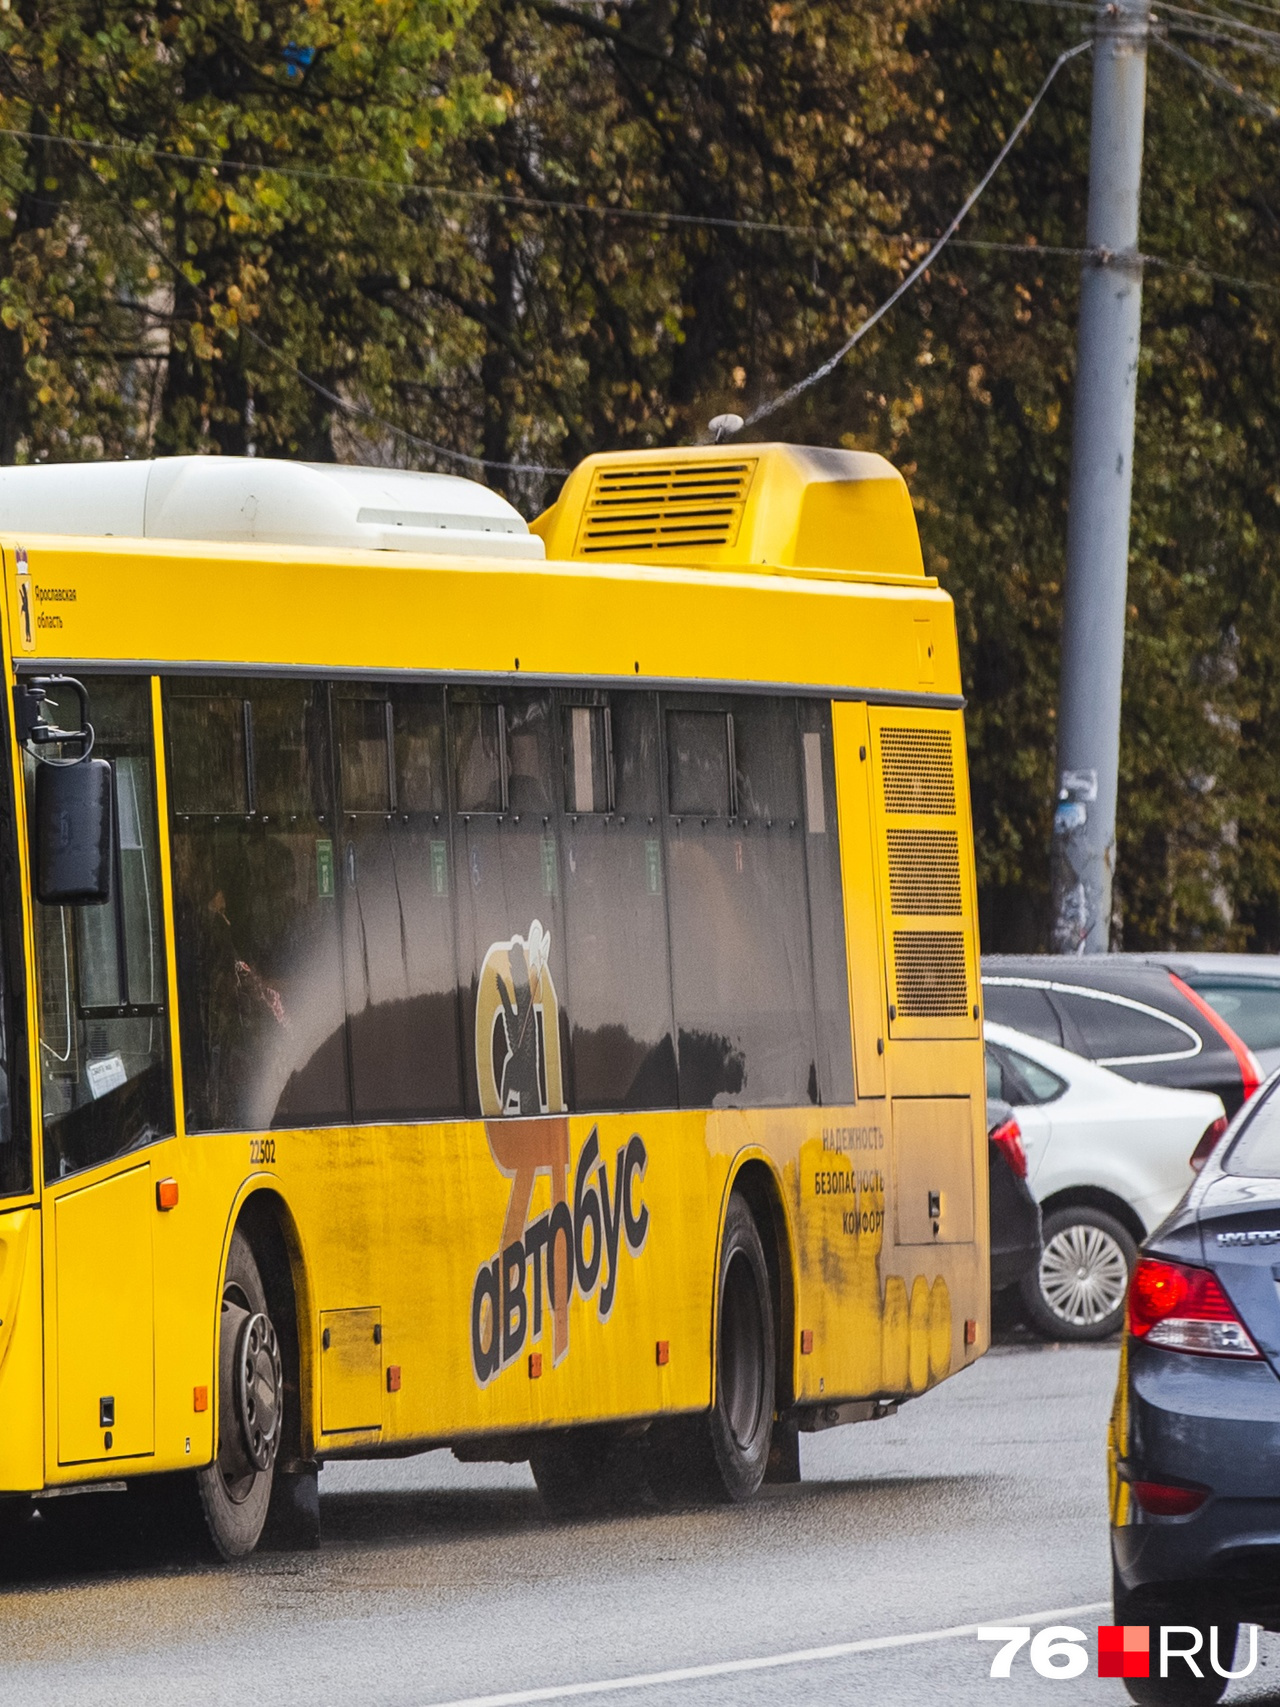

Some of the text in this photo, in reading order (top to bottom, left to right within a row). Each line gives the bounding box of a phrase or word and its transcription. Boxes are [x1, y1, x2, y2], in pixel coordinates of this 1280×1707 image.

[35, 585, 77, 605] Ярославская
[37, 611, 63, 629] область
[250, 1138, 276, 1164] 22502
[822, 1126, 885, 1155] НАДЕЖНОСТЬ
[815, 1168, 885, 1195] БЕЗОПАСНОСТЬ
[842, 1210, 885, 1236] КОМФОРТ
[472, 1124, 649, 1388] автобус
